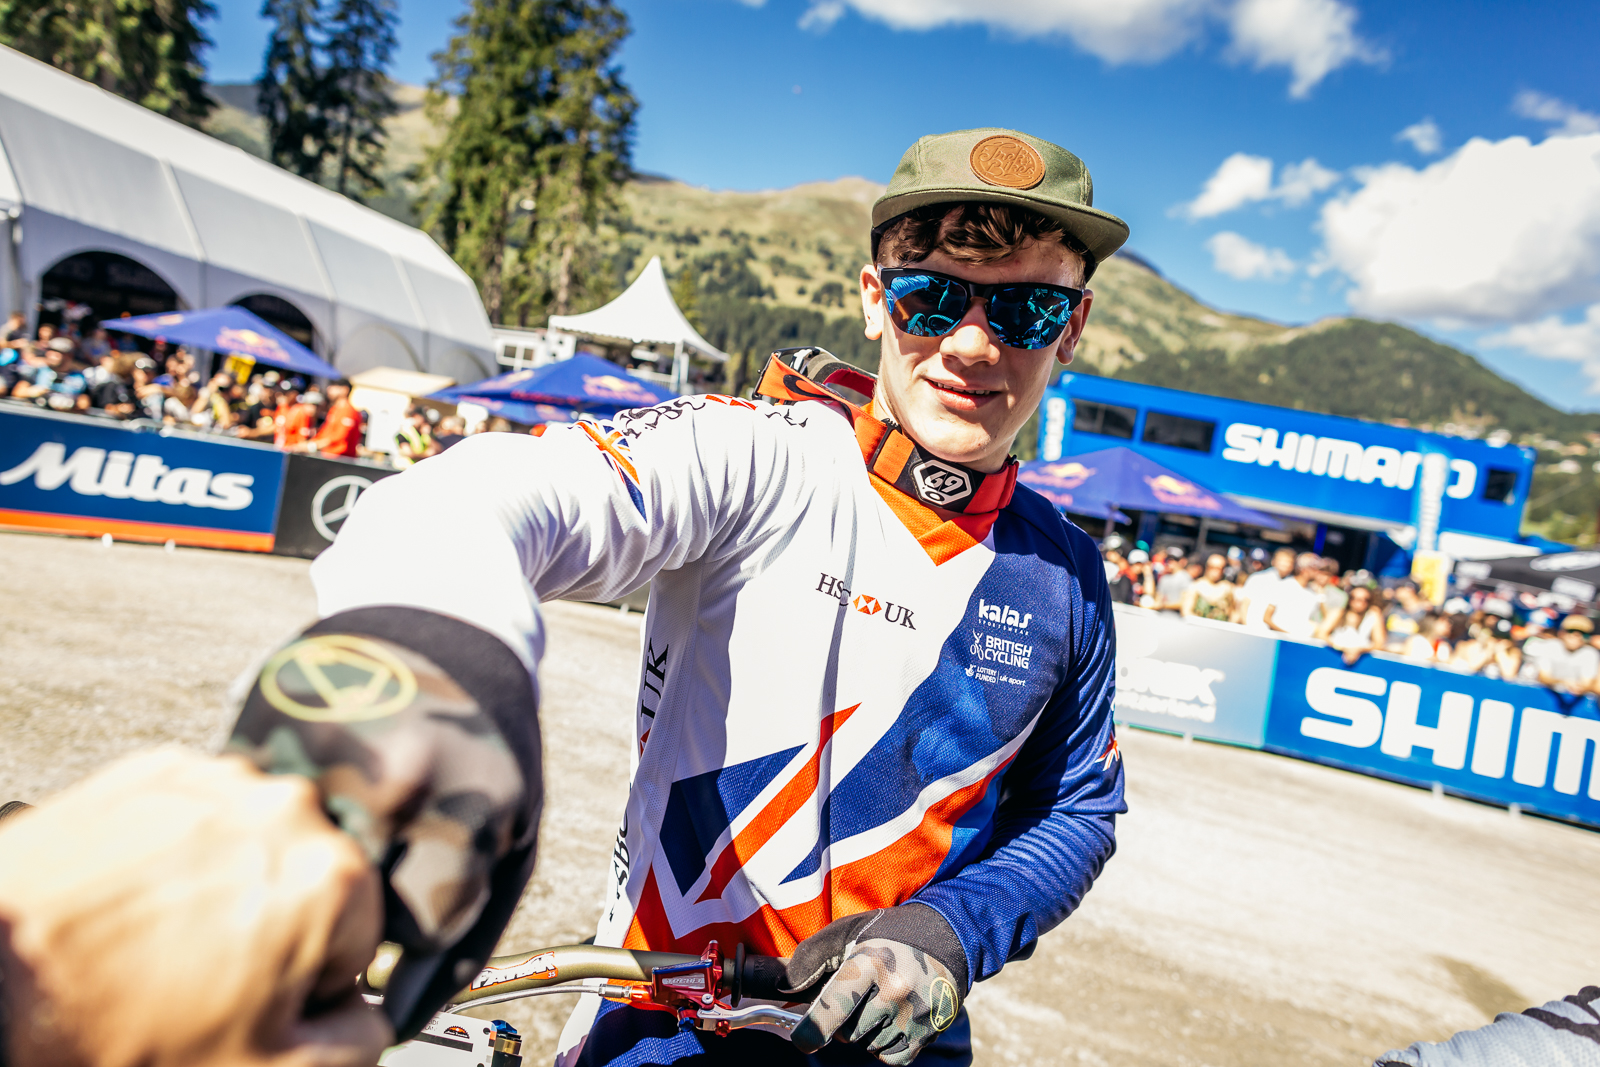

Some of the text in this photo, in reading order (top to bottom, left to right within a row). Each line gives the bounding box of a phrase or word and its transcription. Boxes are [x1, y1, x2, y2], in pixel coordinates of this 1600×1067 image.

[0, 441, 254, 511] Mitas
[884, 601, 917, 631] UK
[978, 598, 1033, 629] kalas
[985, 635, 1033, 658] BRITISH
[984, 648, 1030, 670] CYCLING
[974, 673, 997, 684] FUNDED
[976, 666, 998, 677] LOTTERY
[999, 675, 1026, 687] uk sport
[547, 971, 557, 979] 35
